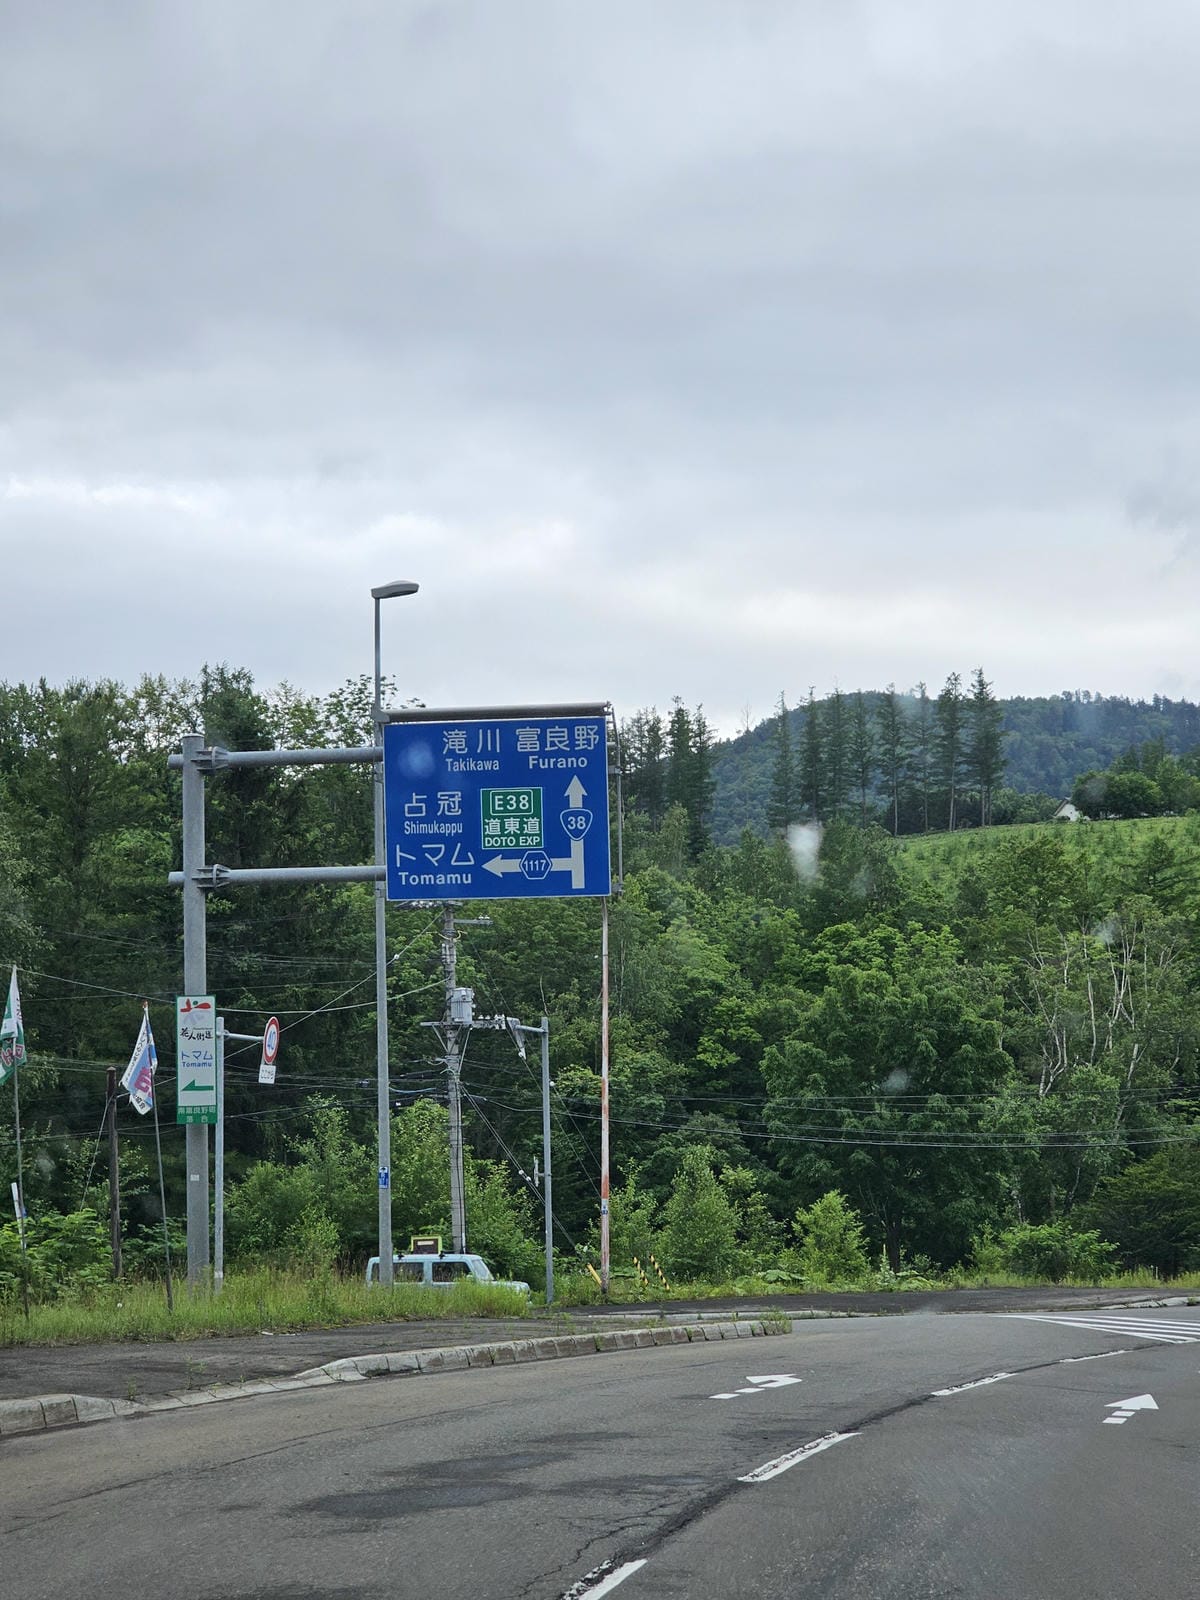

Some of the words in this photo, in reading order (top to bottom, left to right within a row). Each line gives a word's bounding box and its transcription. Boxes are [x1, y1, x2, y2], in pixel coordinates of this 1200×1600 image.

[442, 728, 500, 755] 滝川
[515, 725, 600, 753] 富良野
[445, 758, 500, 772] Takikawa
[528, 755, 588, 769] Furano
[404, 791, 462, 817] 占冠
[494, 794, 530, 811] E38
[404, 820, 463, 837] Shimukappu
[484, 817, 540, 835] 道東道
[567, 815, 586, 830] 38
[484, 836, 516, 847] DOTO
[519, 836, 540, 846] EXP
[396, 842, 475, 868] トマム
[523, 859, 546, 872] 1117
[398, 871, 472, 886] Tomamu
[181, 1050, 213, 1061] トマム
